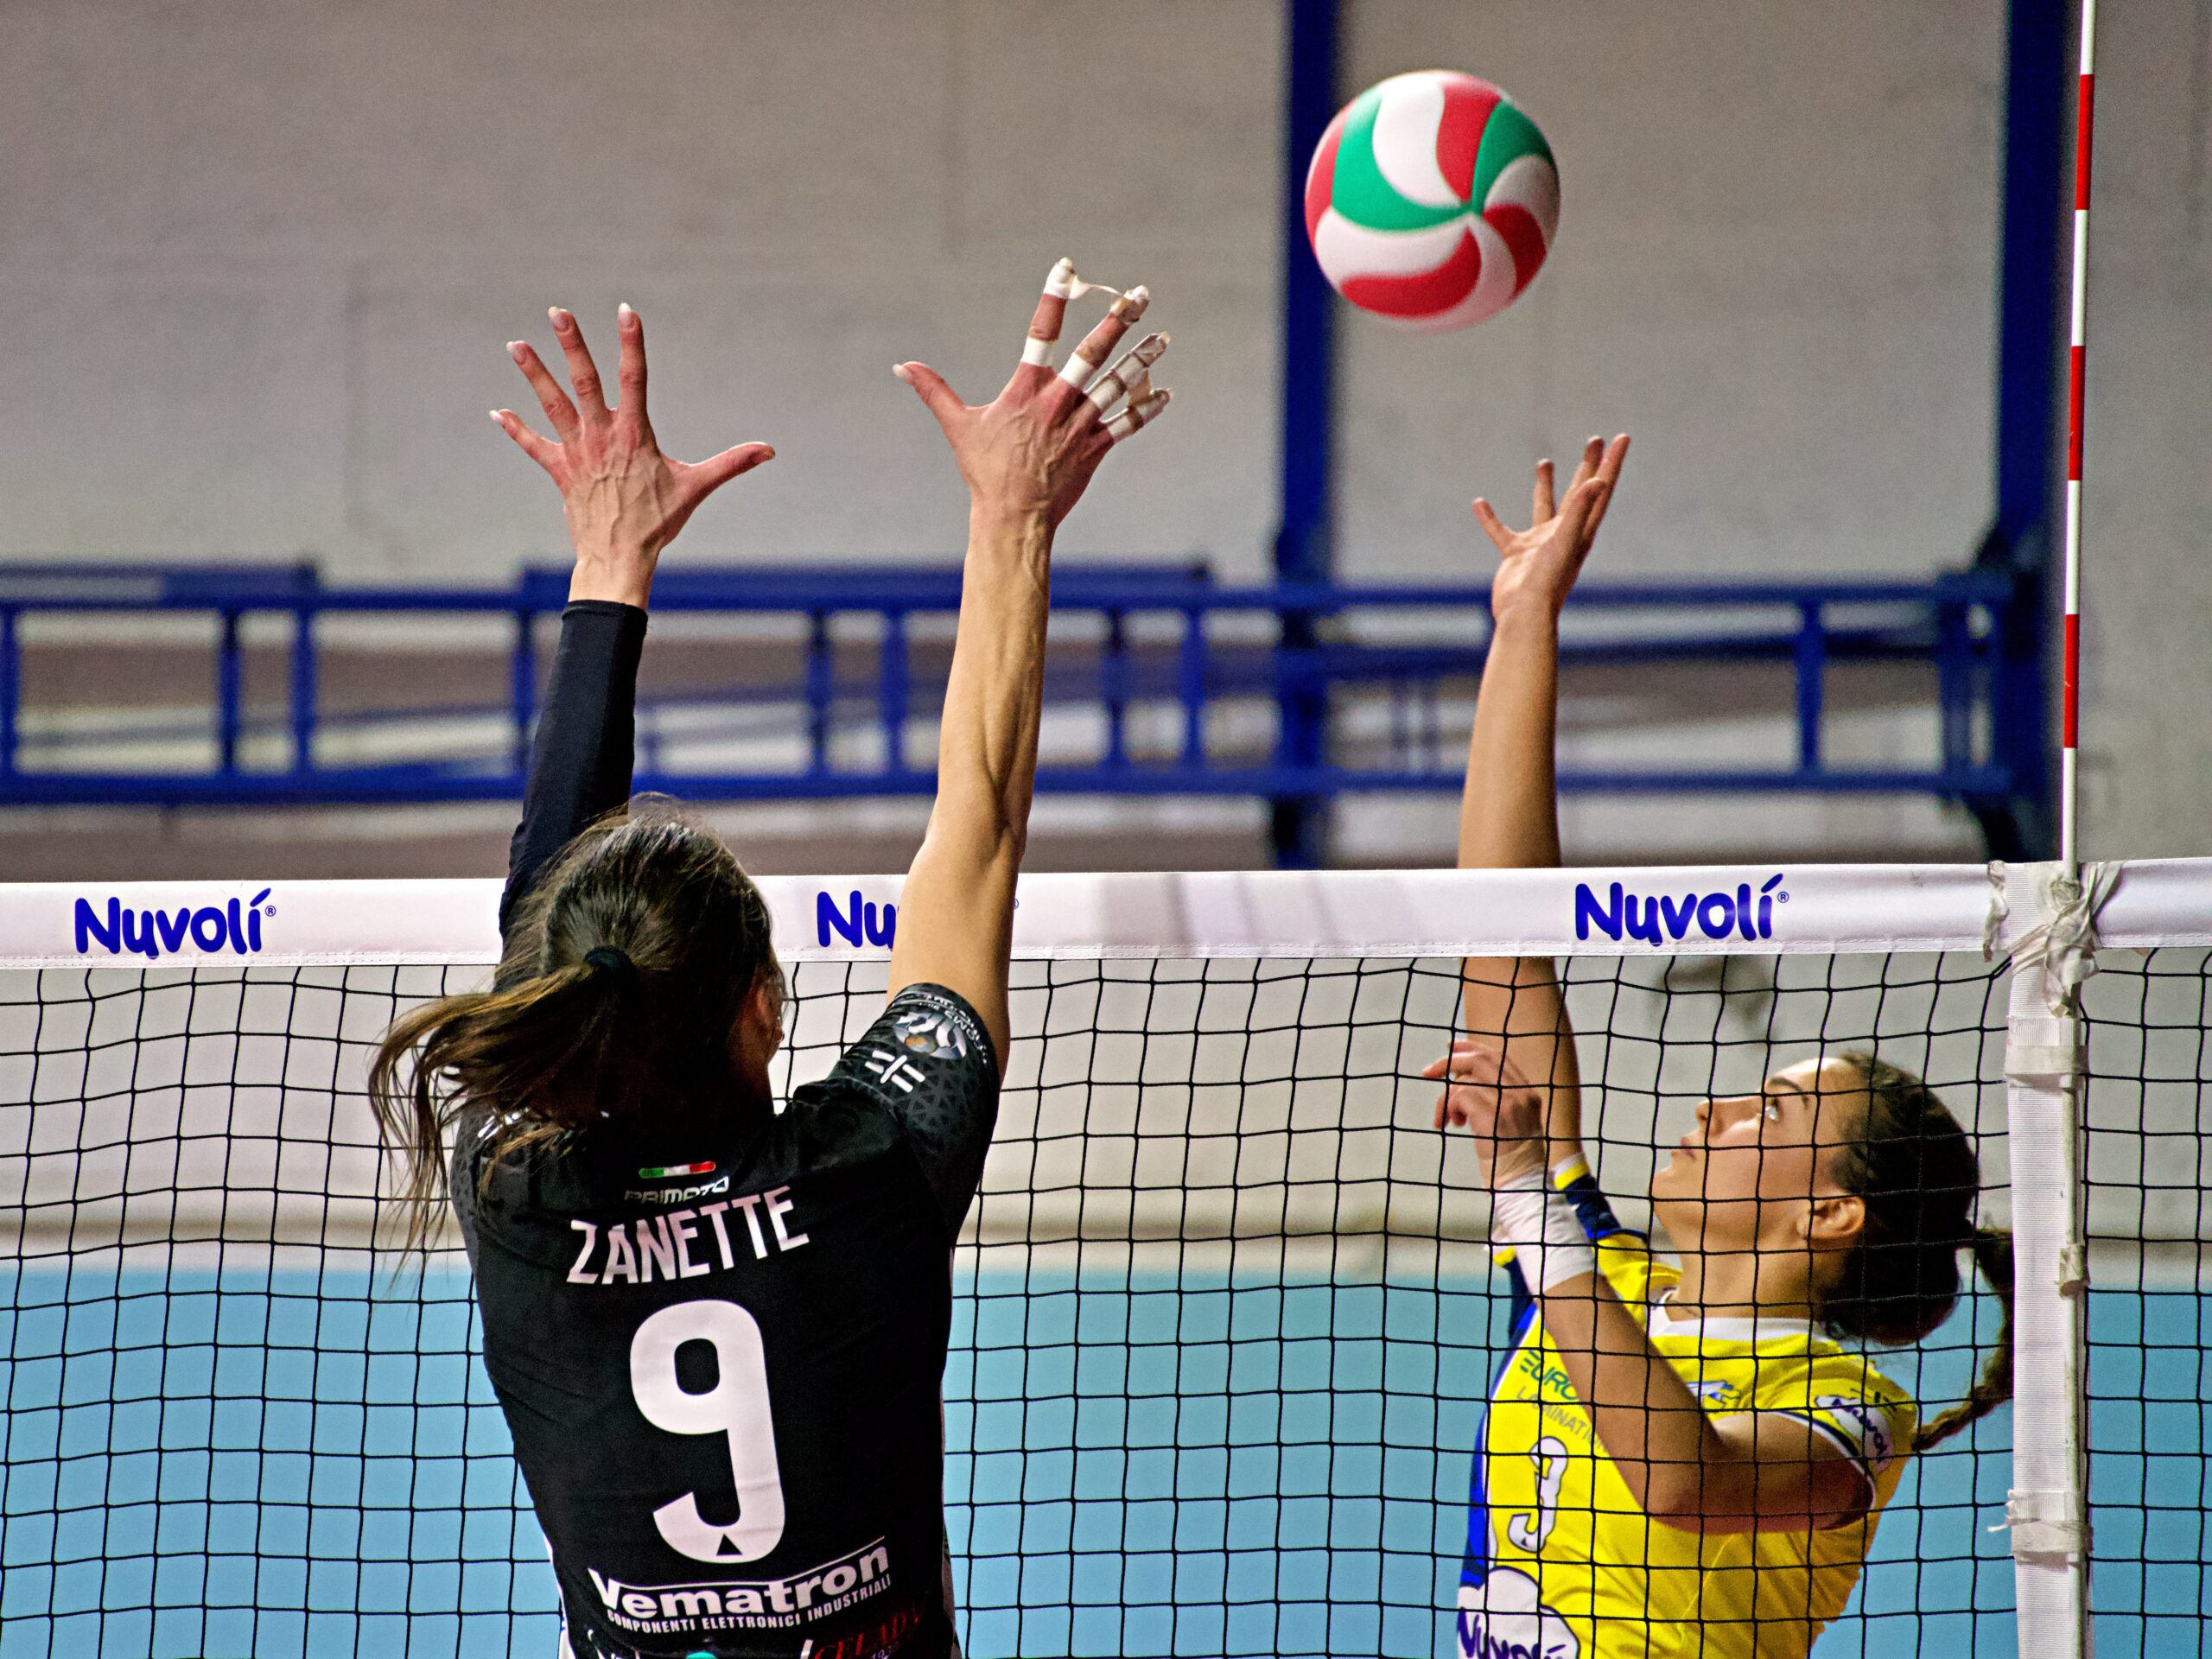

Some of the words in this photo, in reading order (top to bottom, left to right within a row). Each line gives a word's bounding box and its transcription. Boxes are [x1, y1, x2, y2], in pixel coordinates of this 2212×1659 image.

[74, 887, 271, 959] Nuvolí
[1575, 873, 1783, 947] Nuvolí
[566, 1185, 810, 1284] ZANETTE
[630, 1300, 785, 1563] 9
[1507, 1436, 1568, 1554] 3
[588, 1545, 890, 1619] Vematron
[607, 1609, 696, 1634] COMPONENTI
[702, 1613, 801, 1630] ELETTRONICI
[808, 1573, 891, 1623] INDUSTRIALI
